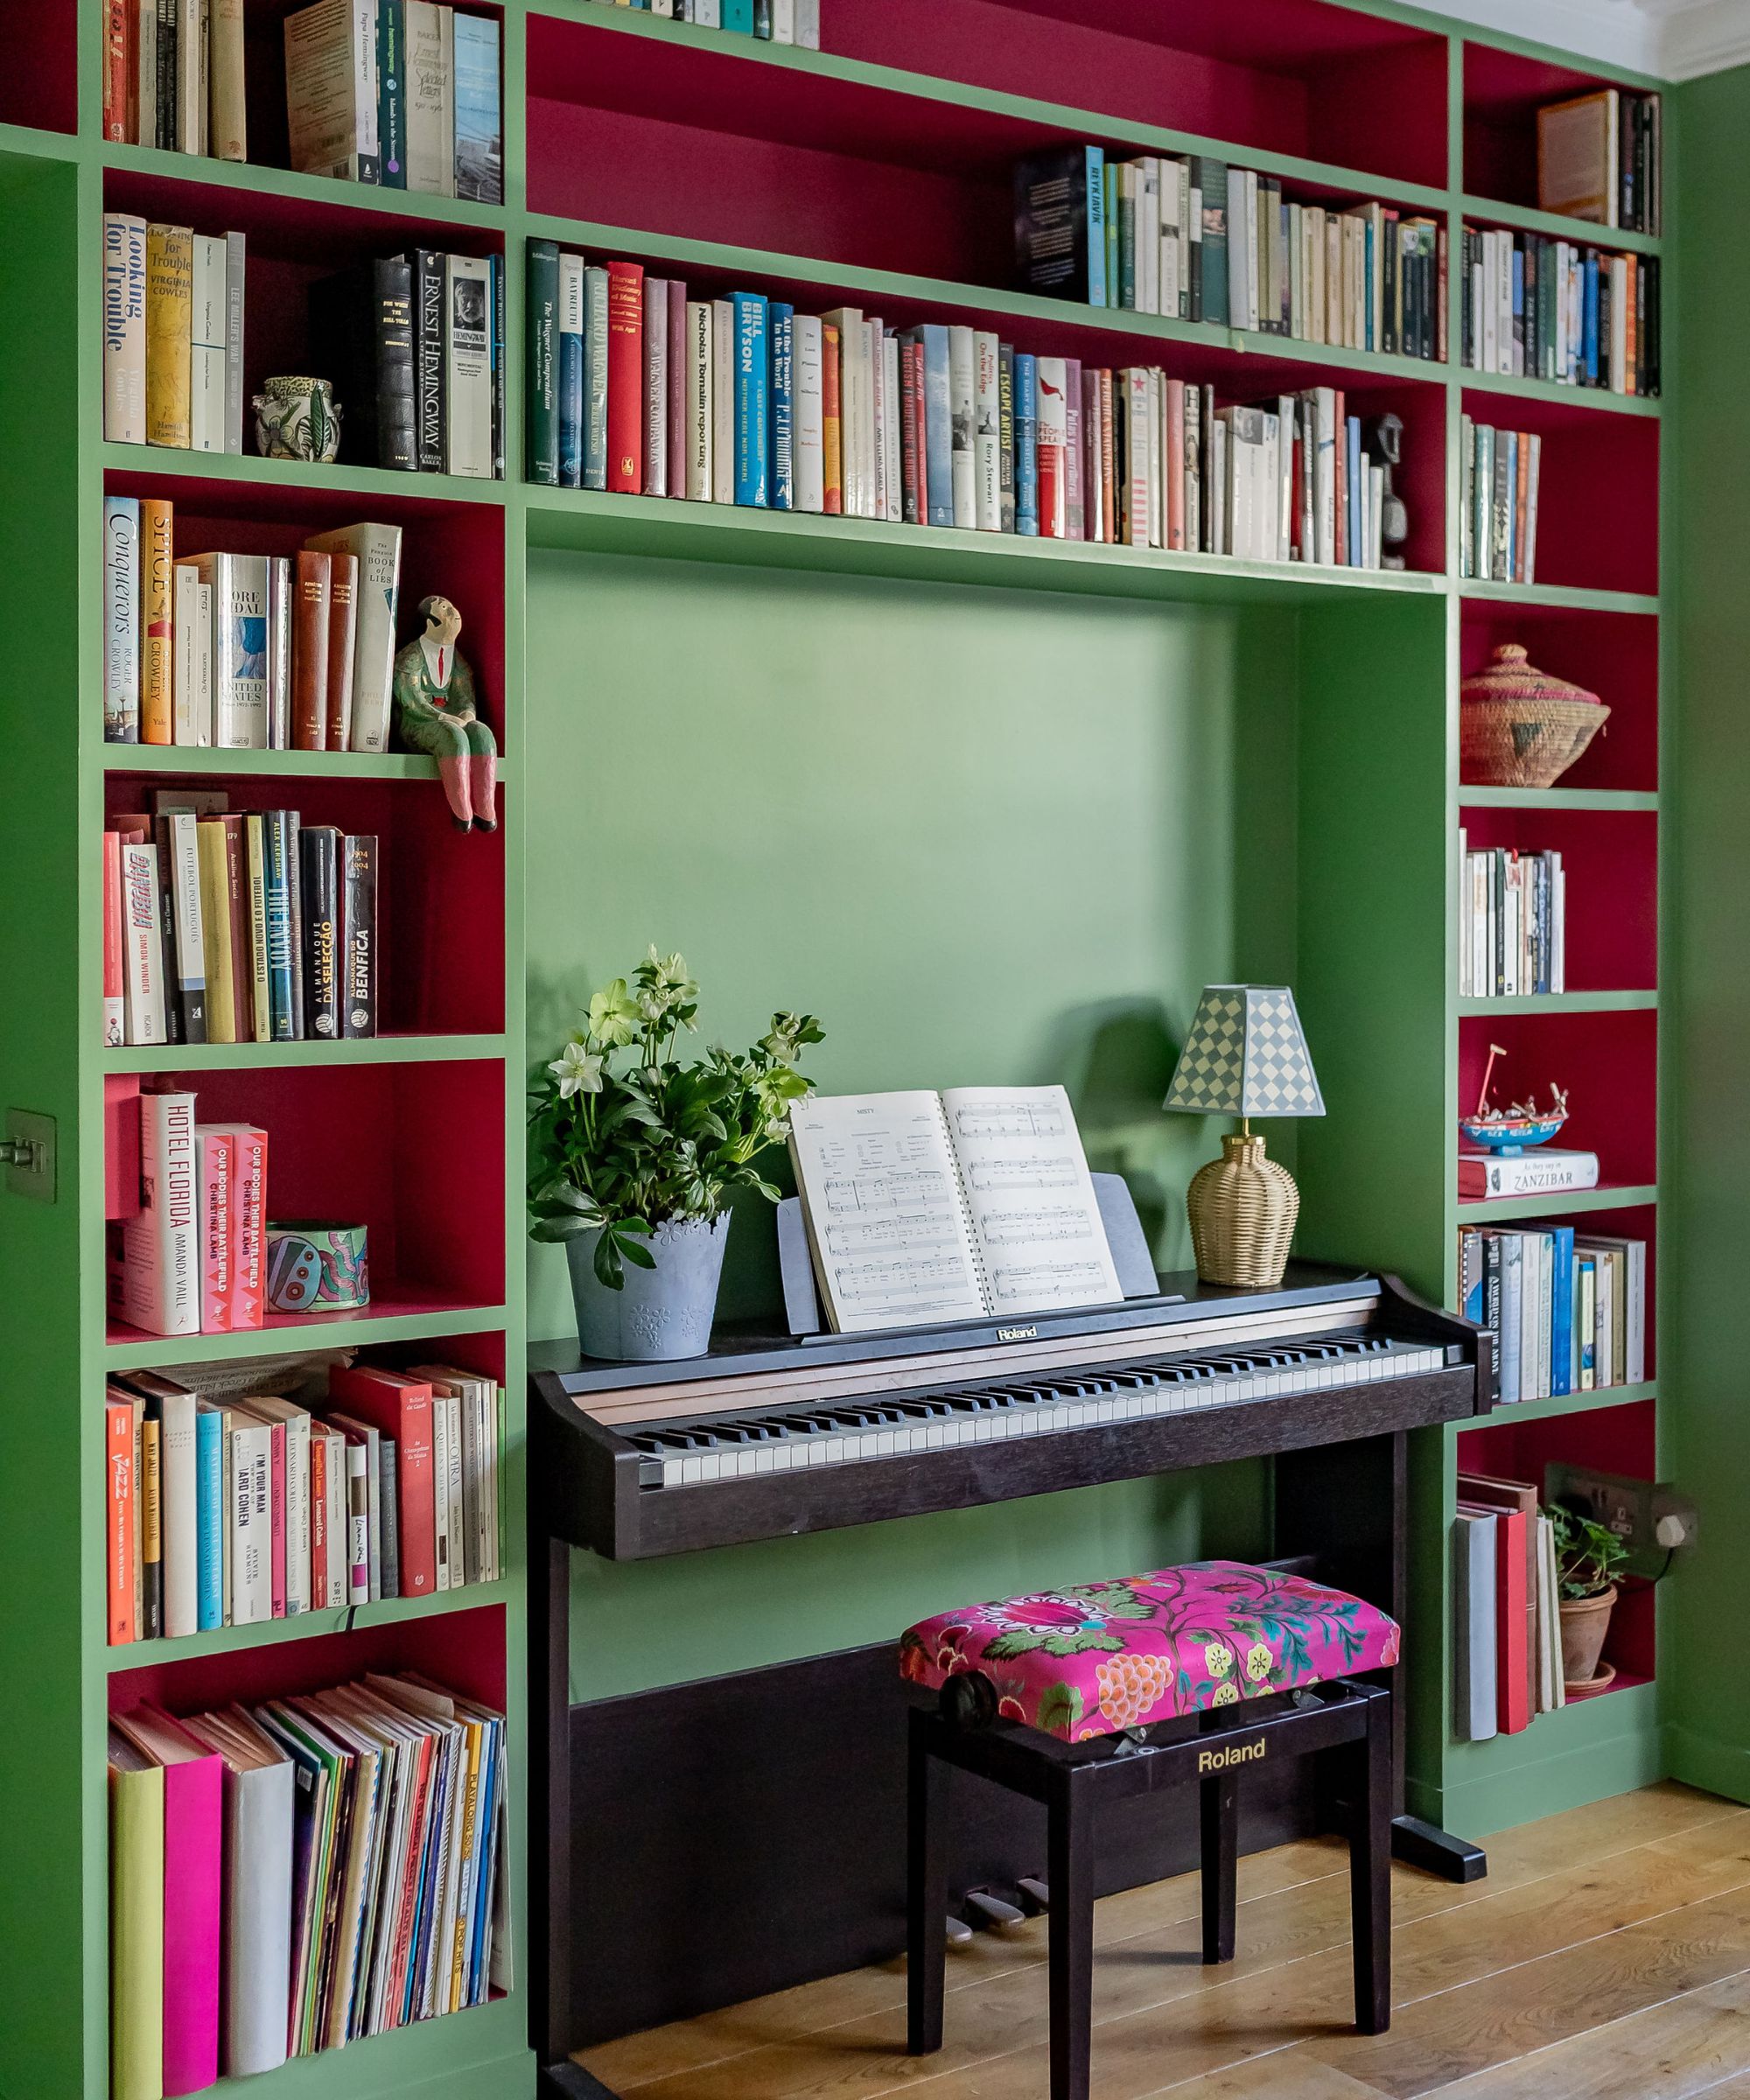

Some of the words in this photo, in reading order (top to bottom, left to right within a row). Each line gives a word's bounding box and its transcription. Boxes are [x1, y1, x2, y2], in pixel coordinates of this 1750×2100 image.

[388, 27, 396, 74] hemingway
[107, 222, 127, 256] for
[164, 240, 181, 256] for
[126, 226, 145, 318] Looking
[150, 253, 192, 272] Trouble
[150, 276, 192, 289] VIRGINIA
[153, 286, 189, 299] COWLES
[231, 287, 240, 302] LEE
[107, 262, 127, 352] Trouble
[425, 275, 441, 337] ERNEST
[544, 301, 553, 318] The
[569, 276, 578, 326] BAYREUTH
[593, 282, 606, 342] RICHARD
[231, 304, 240, 341] MILLER'S
[453, 331, 486, 343] HEMINGWAY
[542, 318, 553, 352] Wagner
[697, 307, 707, 360] Nicholas
[752, 303, 763, 338] BILL
[774, 323, 784, 335] in
[782, 317, 791, 334] All
[231, 345, 240, 362] WAR
[741, 302, 752, 373] BRYSON
[774, 336, 784, 354] the
[782, 336, 791, 354] the
[980, 343, 987, 354] On
[544, 353, 553, 410] Compendium
[592, 343, 606, 397] WAGNER
[650, 355, 661, 402] WAGNER
[774, 355, 784, 388] World
[903, 346, 914, 387] FASCISM
[116, 368, 128, 412] Cowles
[128, 368, 142, 419] Virginia
[425, 340, 441, 450] HEMINGWAY
[698, 362, 707, 410] Tomalin
[1001, 374, 1012, 411] ESCAPE
[904, 396, 914, 444] MADELEINE
[1024, 405, 1031, 416] OF
[650, 404, 661, 466] COMPANION
[696, 411, 707, 469] reporting
[1001, 415, 1012, 451] ARTIST
[420, 453, 442, 462] CARLOS
[905, 448, 915, 490] ALBRIGHT
[985, 443, 994, 464] Rory
[985, 467, 995, 504] Stewart
[152, 516, 172, 593] SPICE
[368, 556, 396, 567] BOOK
[108, 514, 136, 634] Conquerors
[369, 574, 392, 584] LIES
[376, 567, 385, 576] of
[231, 592, 261, 603] ORE
[110, 639, 121, 691] CROWLEY
[124, 648, 133, 684] ROGER
[150, 642, 160, 701] CROWLEY
[152, 718, 166, 726] Yale
[273, 822, 282, 844] ALEX
[186, 847, 196, 886] FUTEBOL
[230, 853, 239, 878] Análise
[274, 845, 284, 878] KERSHAW
[125, 852, 154, 929] DANUBIA
[231, 879, 240, 900] Social
[252, 875, 262, 908] FUTEBOL
[268, 886, 289, 916] THE
[188, 889, 200, 943] PORTUGUÊS
[140, 934, 149, 961] SIMON
[254, 922, 264, 945] NOVO
[270, 920, 291, 971] ENVOY
[350, 940, 356, 950] DO
[256, 946, 264, 975] ESTADO
[313, 921, 322, 1003] ALMANAQUE
[318, 920, 332, 984] SELECÇÃO
[356, 929, 368, 999] BENFICA
[141, 962, 150, 994] WINDER
[323, 985, 332, 1003] DA
[144, 1014, 152, 1038] PICADOR
[168, 1105, 189, 1157] HOTEL
[218, 1150, 228, 1169] OUR
[252, 1146, 262, 1167] OUR
[169, 1160, 191, 1228] FLORIDA
[217, 1171, 228, 1205] BODIES
[252, 1168, 261, 1201] BODIES
[1514, 1172, 1573, 1192] ZANZIBAR
[209, 1183, 218, 1232] CHRISTINA
[217, 1207, 228, 1232] THEIR
[243, 1180, 252, 1228] CHRISTINA
[250, 1204, 261, 1228] THEIR
[175, 1233, 186, 1277] AMANDA
[208, 1235, 218, 1260] LAMB
[242, 1230, 250, 1256] LAMB
[250, 1230, 260, 1288] BATTLEFIELD
[217, 1234, 228, 1292] BATTLEFIELD
[176, 1281, 187, 1310] VAILL
[998, 1326, 1038, 1340] Roland
[211, 1446, 220, 1492] MATTERS
[256, 1453, 266, 1468] I'M
[315, 1445, 324, 1474] Beautiful
[112, 1453, 130, 1500] JAZZ
[256, 1470, 266, 1493] YOUR
[315, 1475, 324, 1496] Losers
[211, 1495, 220, 1507] OF
[238, 1494, 250, 1528] COHEN
[256, 1494, 266, 1514] MAN
[315, 1500, 324, 1526] Leonard
[211, 1510, 220, 1543] VITAL
[315, 1526, 324, 1546] Cohen
[211, 1544, 220, 1600] INTEREST
[1199, 1738, 1265, 1773] Roland
[466, 1773, 478, 1832] PLAYALONG
[464, 1834, 472, 1861] 50/50
[461, 1863, 471, 1889] ALTO
